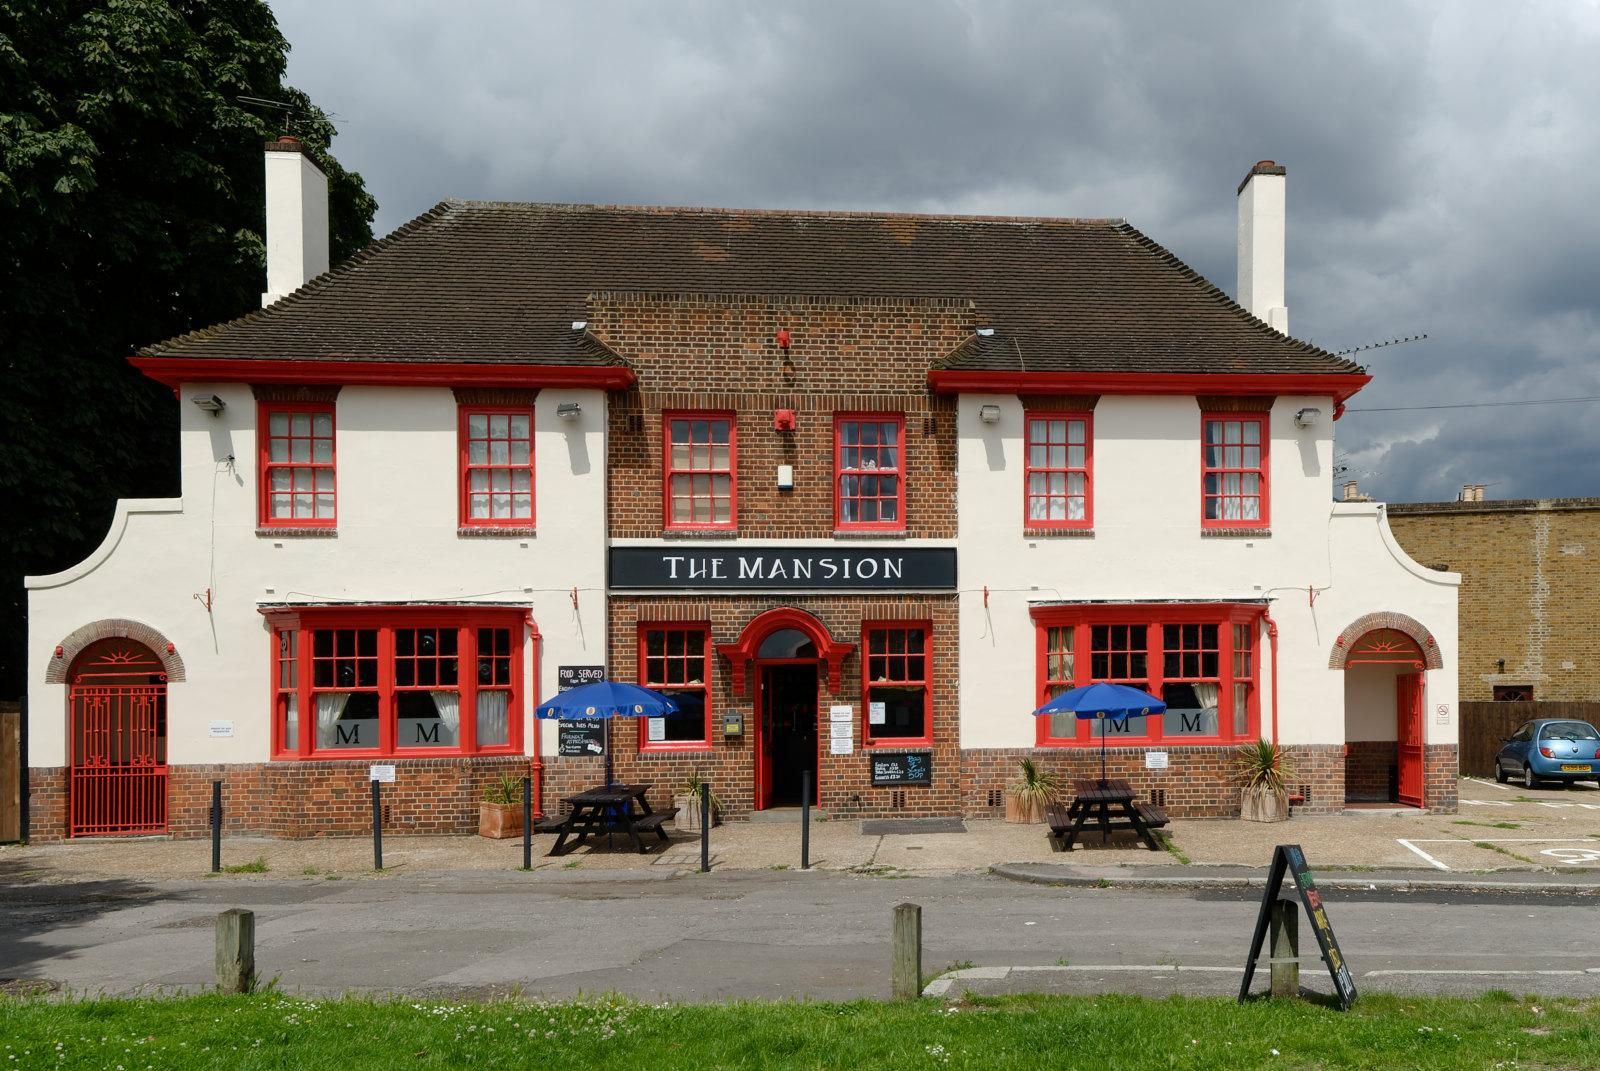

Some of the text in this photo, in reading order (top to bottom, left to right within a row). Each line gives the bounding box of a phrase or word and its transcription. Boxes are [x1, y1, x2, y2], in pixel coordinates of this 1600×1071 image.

[662, 556, 903, 579] THE MANSION
[560, 669, 603, 679] FOOD SERVED
[1180, 713, 1202, 732] M
[335, 724, 360, 745] M
[416, 723, 440, 743] M
